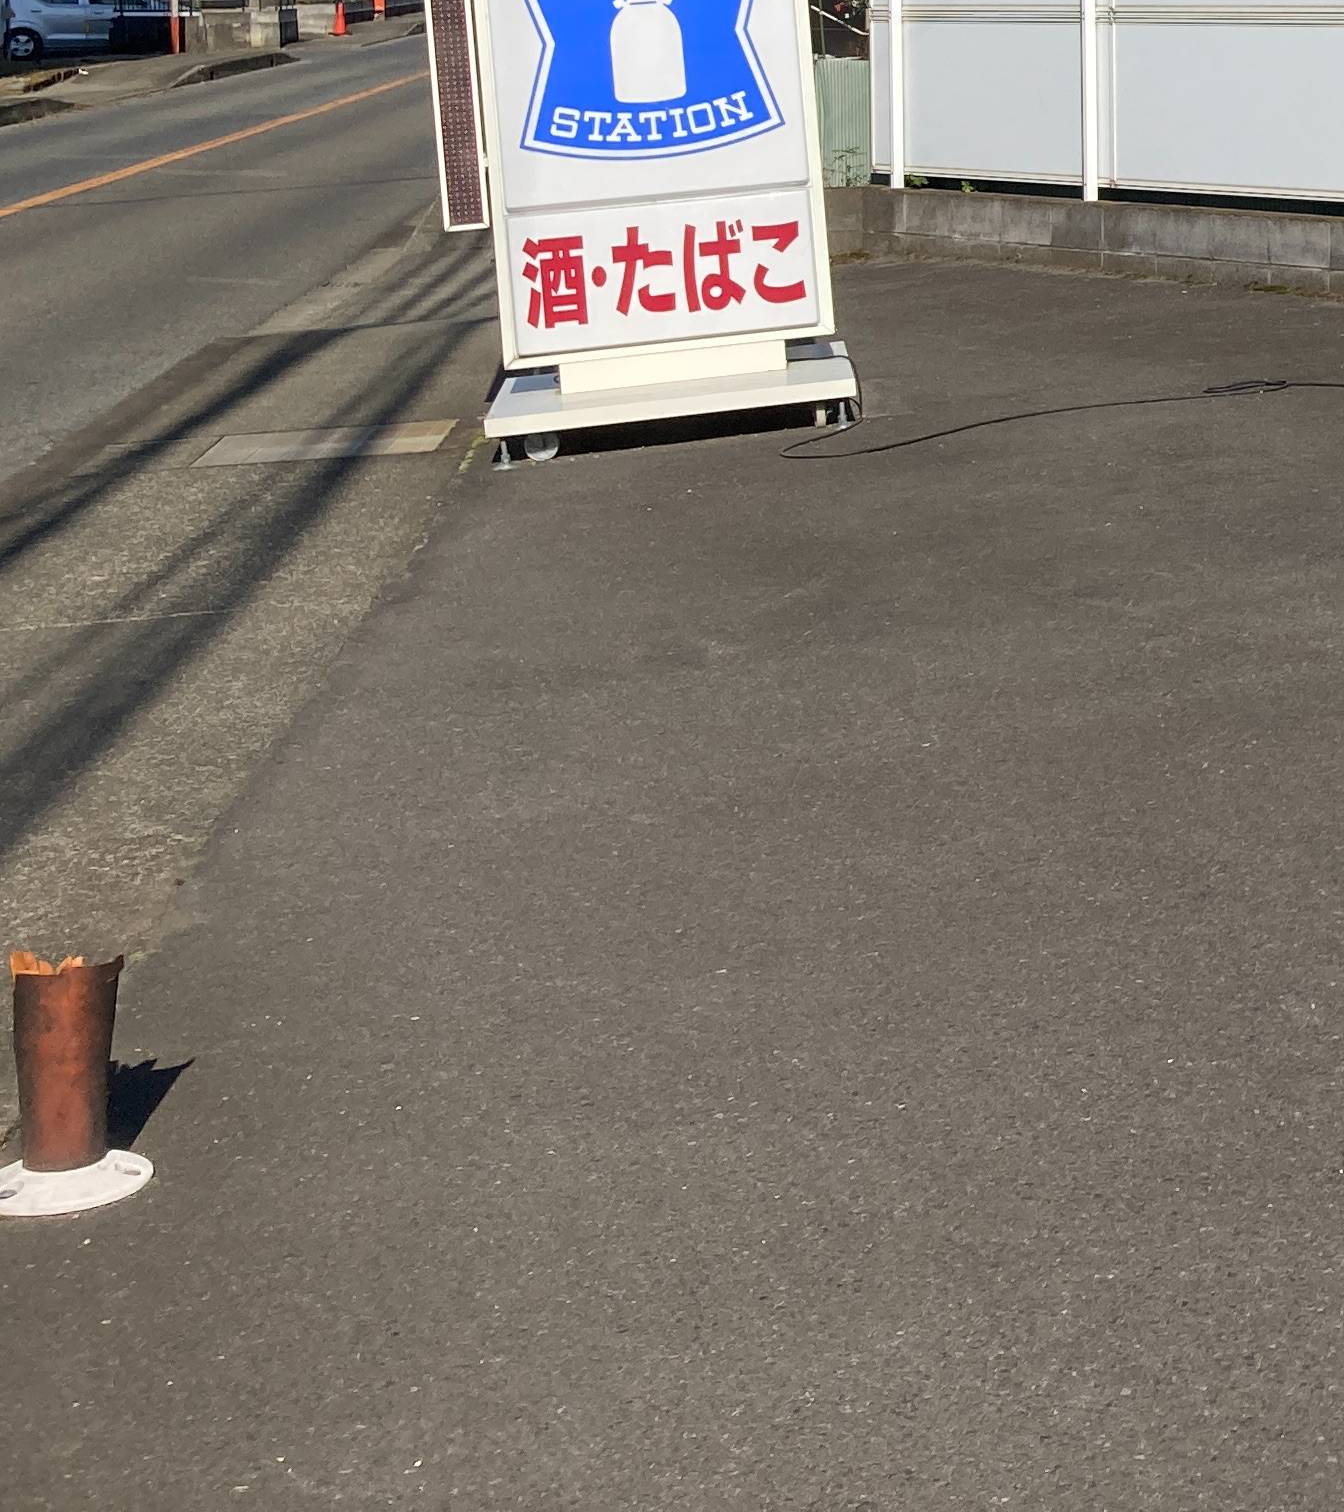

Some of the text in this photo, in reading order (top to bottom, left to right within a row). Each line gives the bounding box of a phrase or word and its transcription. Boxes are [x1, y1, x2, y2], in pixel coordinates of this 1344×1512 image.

[549, 90, 755, 143] STATION
[521, 219, 807, 329] 酒・たばこ
